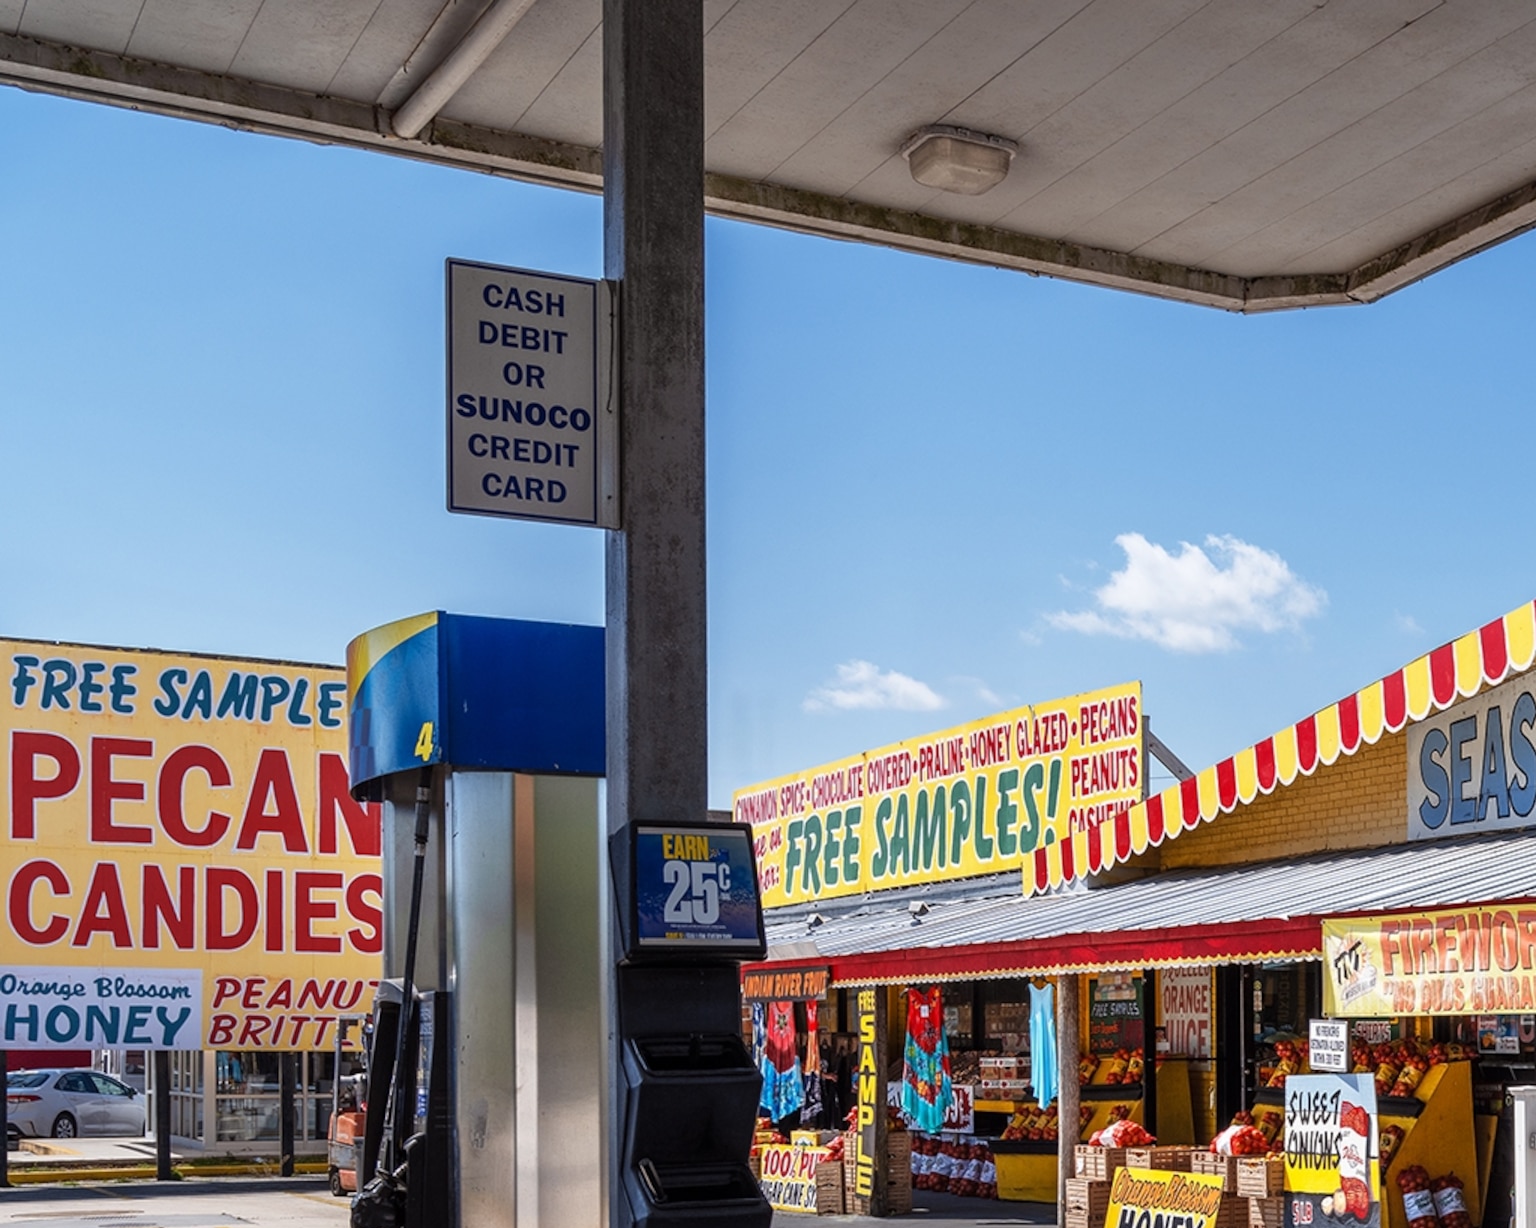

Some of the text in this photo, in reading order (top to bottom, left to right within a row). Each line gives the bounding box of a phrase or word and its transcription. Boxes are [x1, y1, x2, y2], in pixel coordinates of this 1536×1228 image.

[482, 283, 565, 317] CASH
[478, 320, 568, 354] DEBIT
[503, 361, 546, 390] OR
[456, 393, 591, 432] SUNOCO
[467, 433, 580, 468] CREDIT
[481, 472, 567, 503] CARD
[12, 655, 139, 714] FREE
[414, 720, 436, 763] 4
[735, 695, 1138, 824] CINNAMON SPICE CHOCOLATE COVERED PRALINE HONEY GLAZED PECANS
[1071, 746, 1138, 798] PEANUTS
[11, 730, 382, 856] PECAN
[785, 758, 1062, 895] FREE SAMPLES!
[662, 833, 710, 861] EARN
[8, 859, 382, 953] CANDIES
[1, 973, 192, 999] Orange Blossom
[212, 978, 380, 1010] PEANU
[858, 989, 876, 1011] FREE
[1163, 984, 1209, 1014] ORANGE
[1420, 977, 1465, 1012] DUDS
[4, 1003, 191, 1046] HONEY
[208, 1014, 356, 1048] BRITT
[855, 1013, 877, 1196] SAMPLE
[1287, 1089, 1342, 1127] SWEET
[763, 1147, 801, 1179] 100%
[1287, 1130, 1342, 1170] ONIONS
[1111, 1168, 1221, 1218] Orange Blossom
